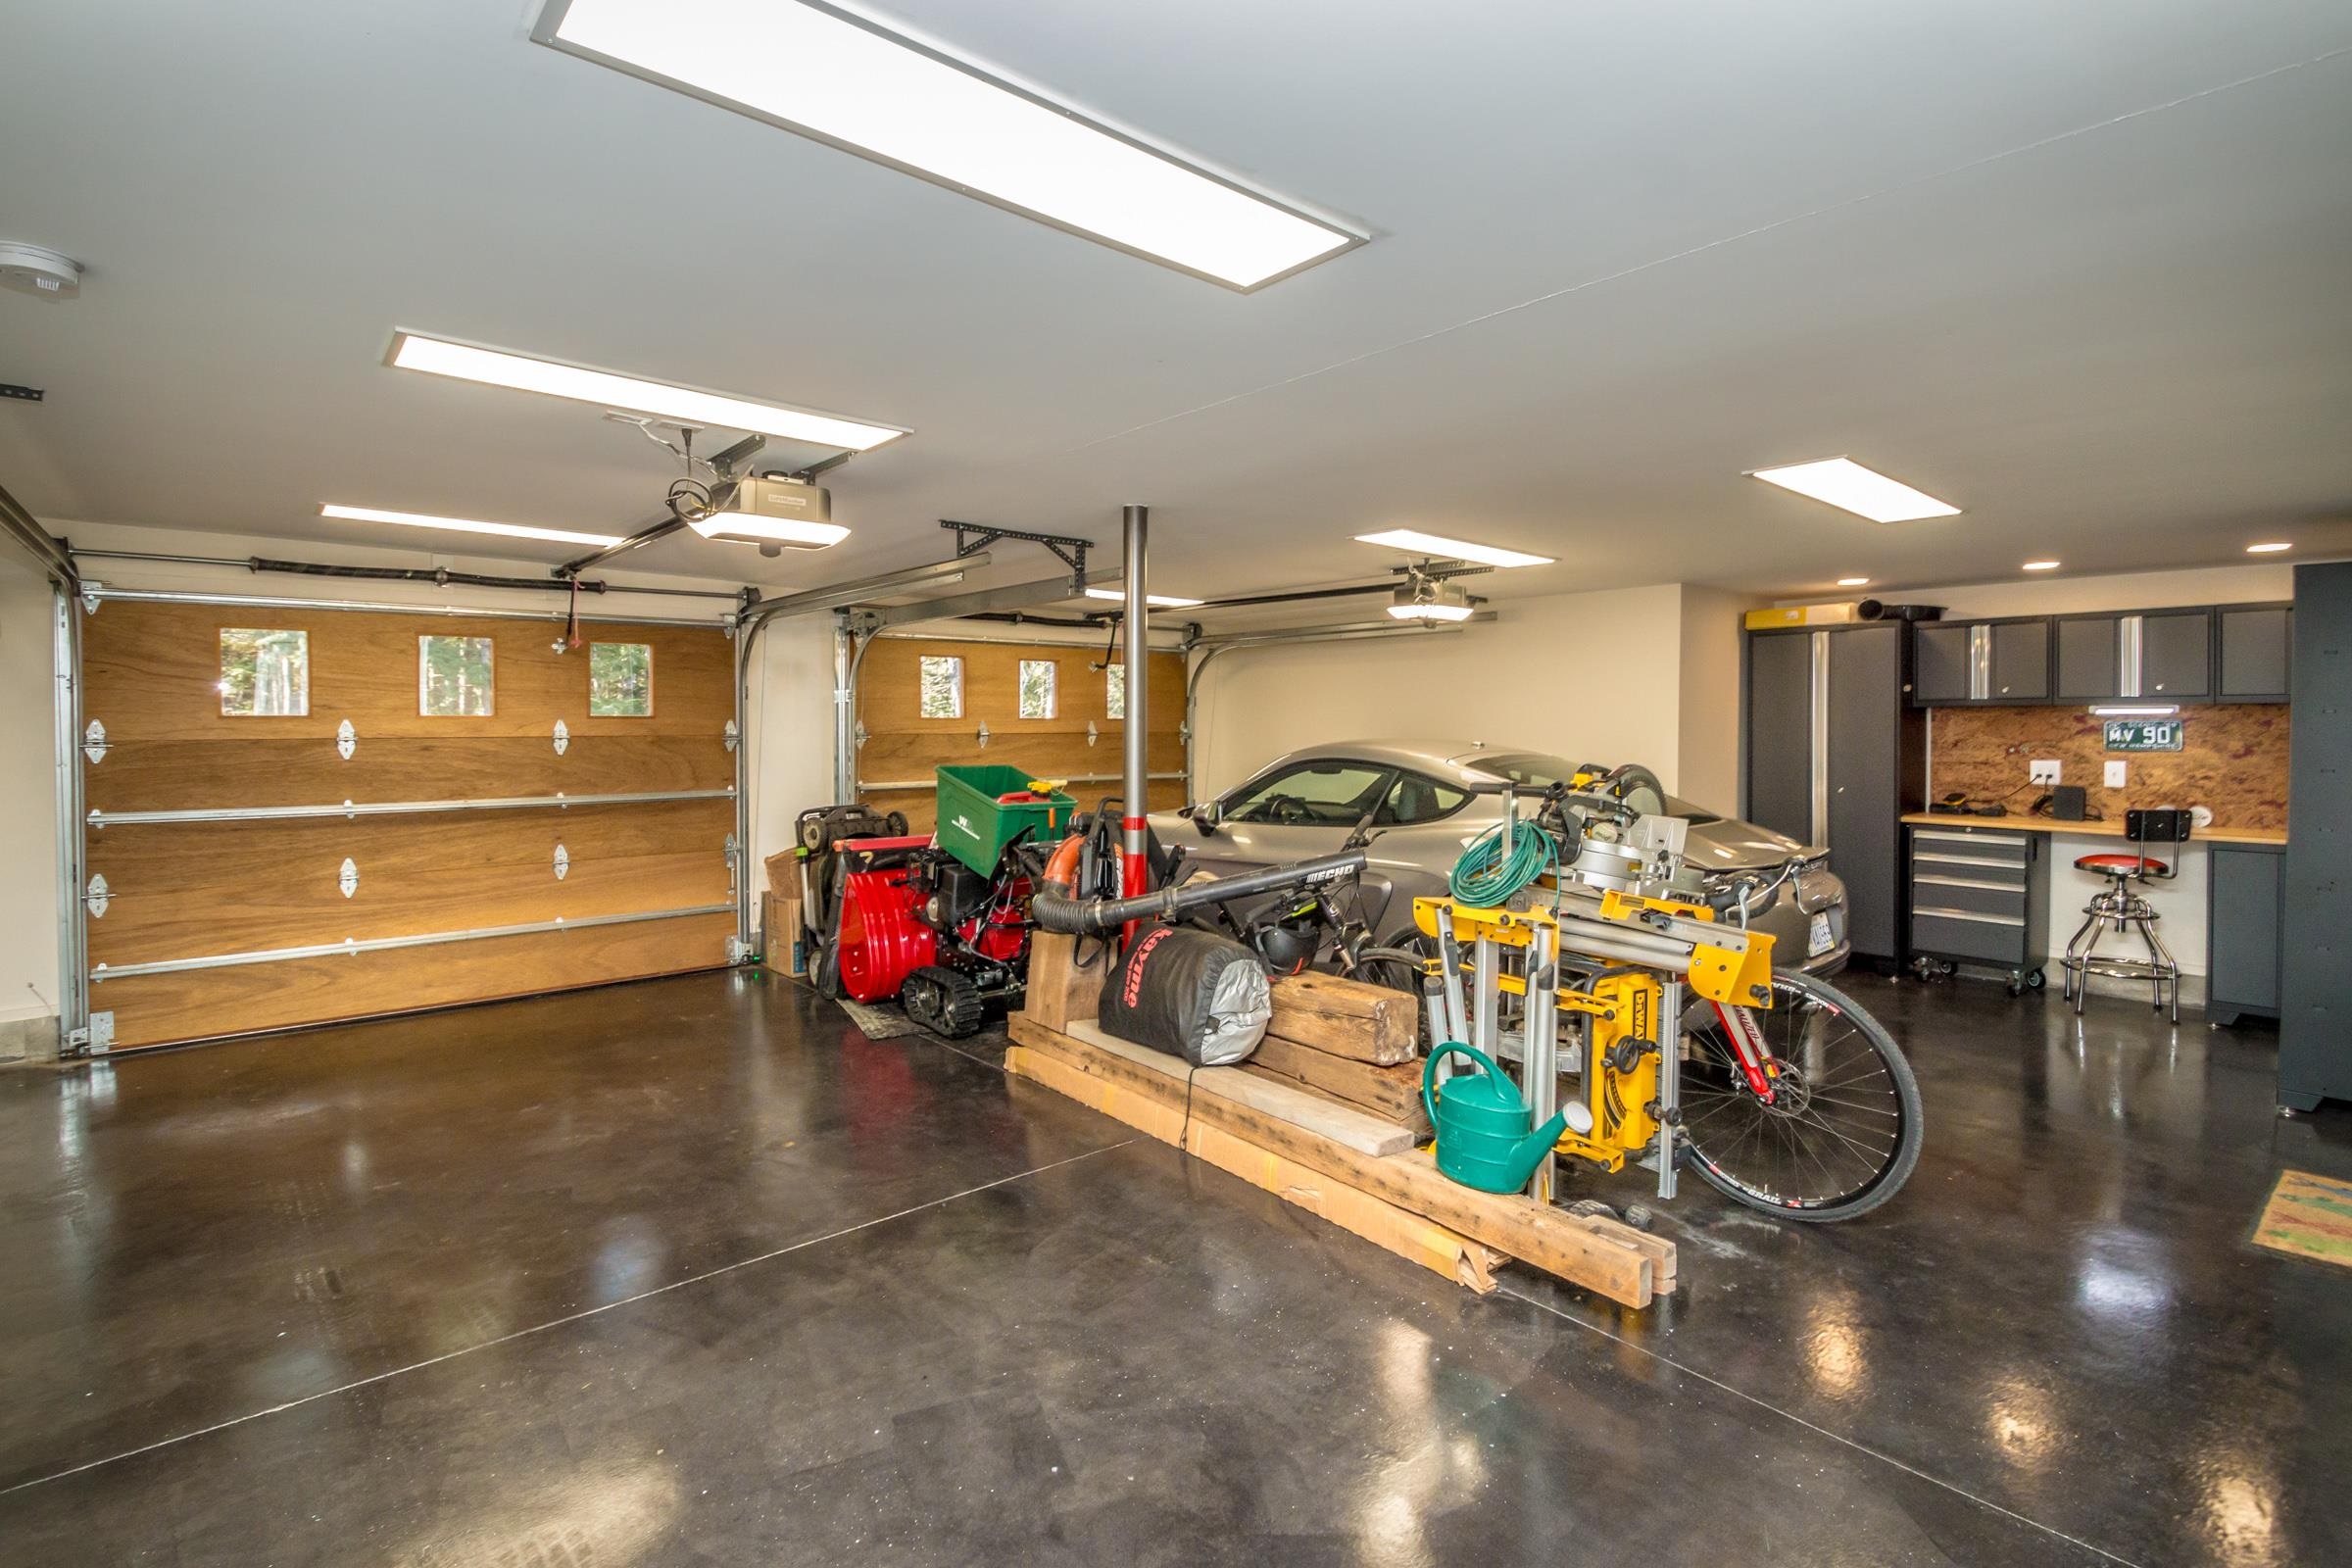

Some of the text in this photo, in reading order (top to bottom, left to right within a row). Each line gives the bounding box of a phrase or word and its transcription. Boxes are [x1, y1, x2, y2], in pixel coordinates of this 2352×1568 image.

[2142, 725, 2171, 744] 90
[1316, 864, 1354, 881] ECHO
[1635, 992, 1644, 1039] DEWA
